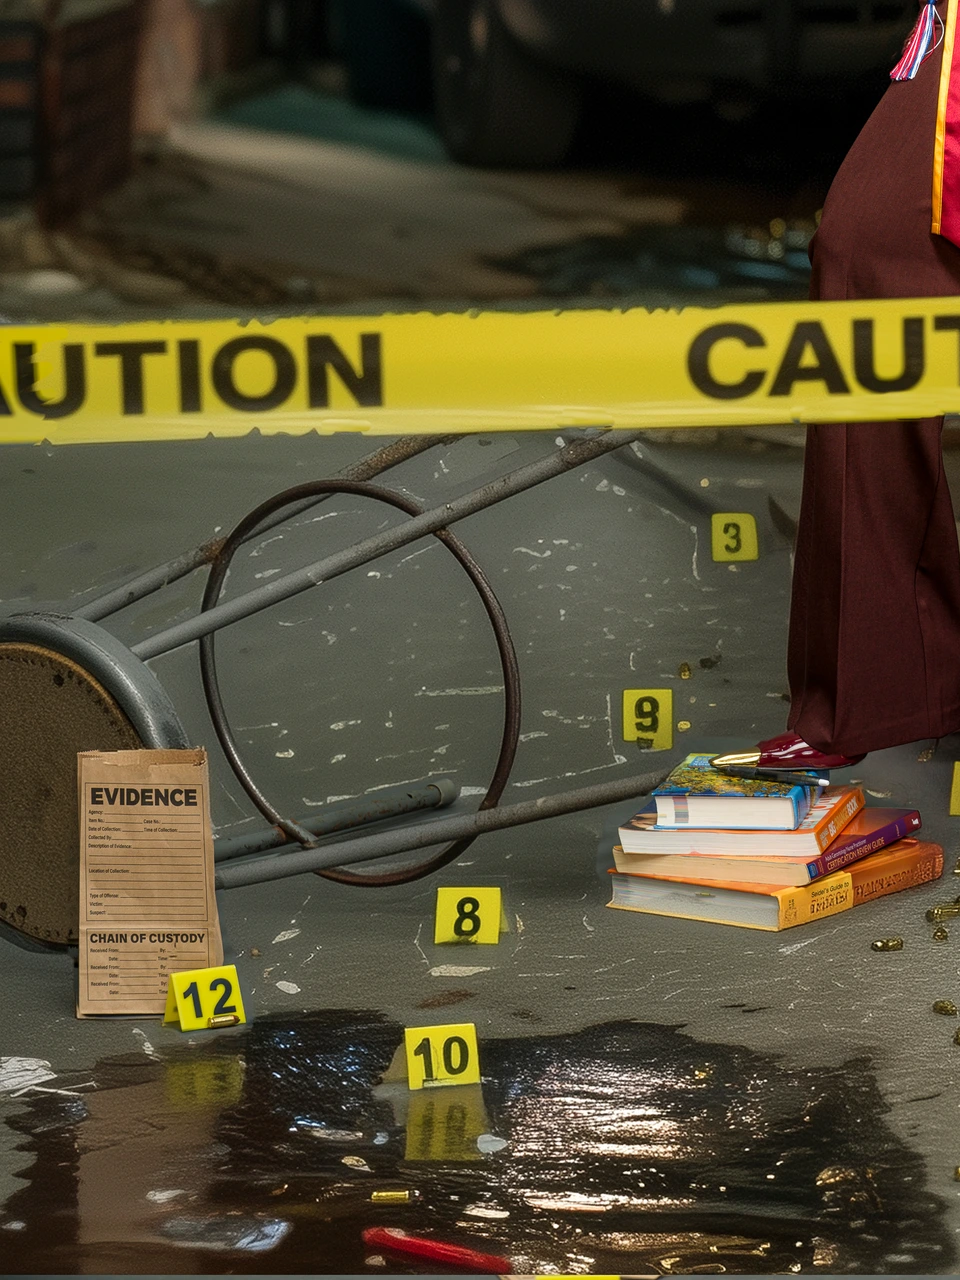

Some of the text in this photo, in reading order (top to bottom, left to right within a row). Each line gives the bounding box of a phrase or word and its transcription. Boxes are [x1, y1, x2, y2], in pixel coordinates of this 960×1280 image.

[0, 333, 383, 420] UTION
[722, 522, 741, 554] 3
[91, 787, 198, 807] EVIDENCE
[811, 888, 829, 898] Seidel's
[829, 884, 844, 892] Guide
[453, 896, 481, 937] 8
[90, 933, 205, 943] CHAIN OF CUSTODY
[183, 977, 237, 1019] 12
[414, 1035, 469, 1081] 10
